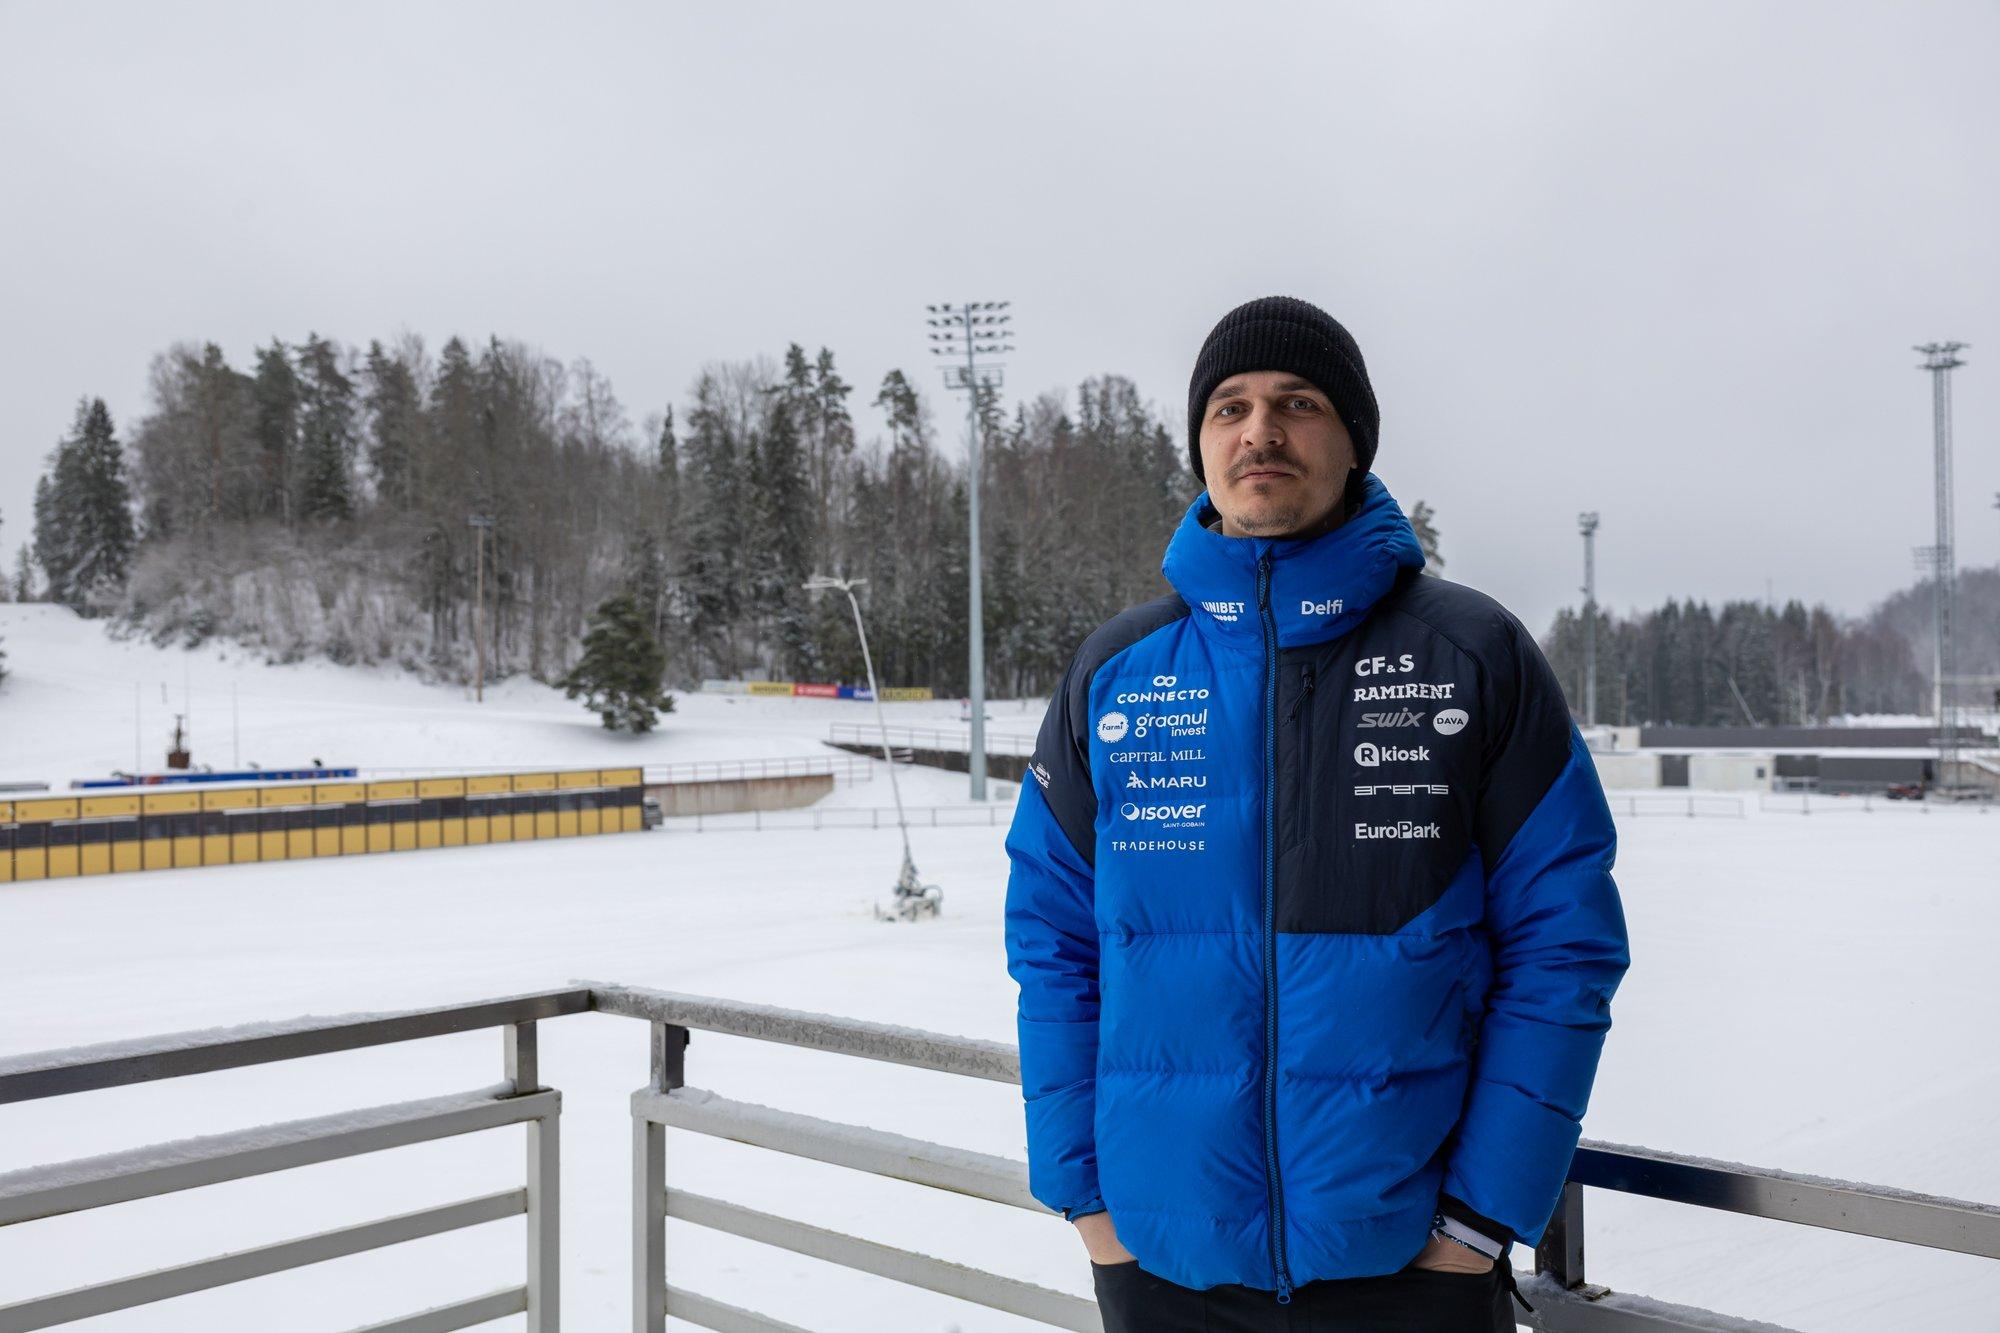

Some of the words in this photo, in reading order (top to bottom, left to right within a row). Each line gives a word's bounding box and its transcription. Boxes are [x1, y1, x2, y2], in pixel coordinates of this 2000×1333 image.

[1202, 602, 1244, 613] UNIBET
[1302, 600, 1342, 615] Delfi
[1117, 689, 1209, 704] CONNECTO
[1354, 683, 1454, 701] RAMIRENT
[1102, 721, 1124, 731] Farmi
[1135, 708, 1208, 738] graanul
[1436, 716, 1464, 726] DAVA
[1170, 724, 1205, 736] invest
[1171, 750, 1205, 761] MILL
[1382, 746, 1429, 761] kiosk
[1151, 776, 1206, 788] MARU
[1355, 785, 1448, 795] arens
[1162, 821, 1205, 829] SAINT-GOBAIN
[1355, 821, 1440, 839] EuroPark
[1112, 840, 1205, 851] TRADEHOUSE
